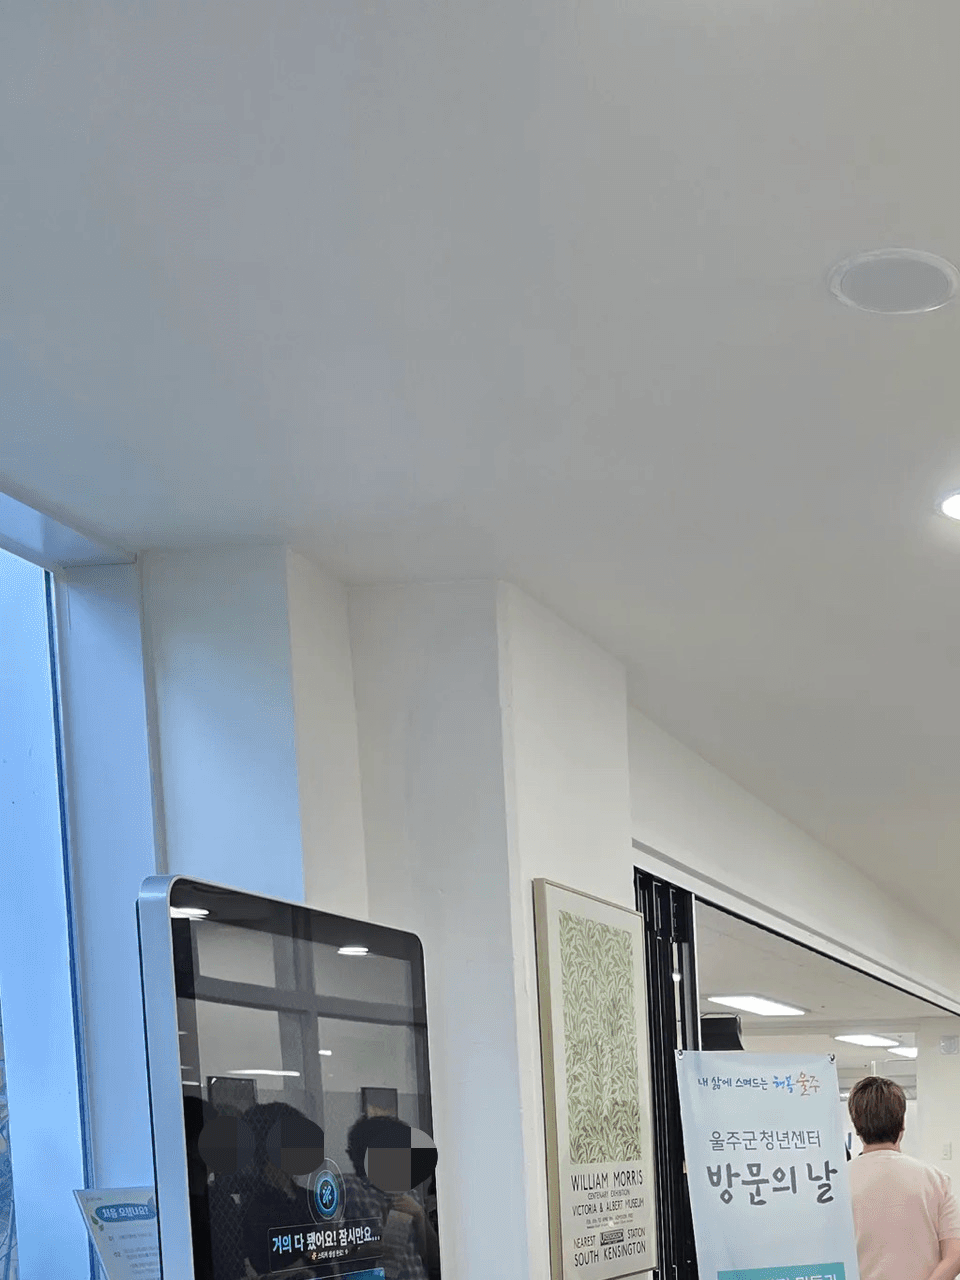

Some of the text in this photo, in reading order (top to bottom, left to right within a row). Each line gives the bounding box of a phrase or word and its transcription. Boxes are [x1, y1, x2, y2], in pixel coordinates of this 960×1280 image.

[698, 1071, 821, 1096] 내 삶에 스며드는 행복 울주
[709, 1130, 821, 1151] 울주군청년센터
[570, 1169, 644, 1192] WILLIAM MORRIS
[706, 1160, 838, 1206] 방문의 날
[572, 1198, 644, 1216] VICTORIA & ALBERT MUSEUM
[272, 1235, 292, 1254] 거의
[294, 1233, 305, 1251] 다
[306, 1231, 337, 1251] 됐어요!
[573, 1235, 596, 1249] NEAREST
[627, 1227, 646, 1239] STATION
[574, 1240, 646, 1267] SOUTH KENSINGTON
